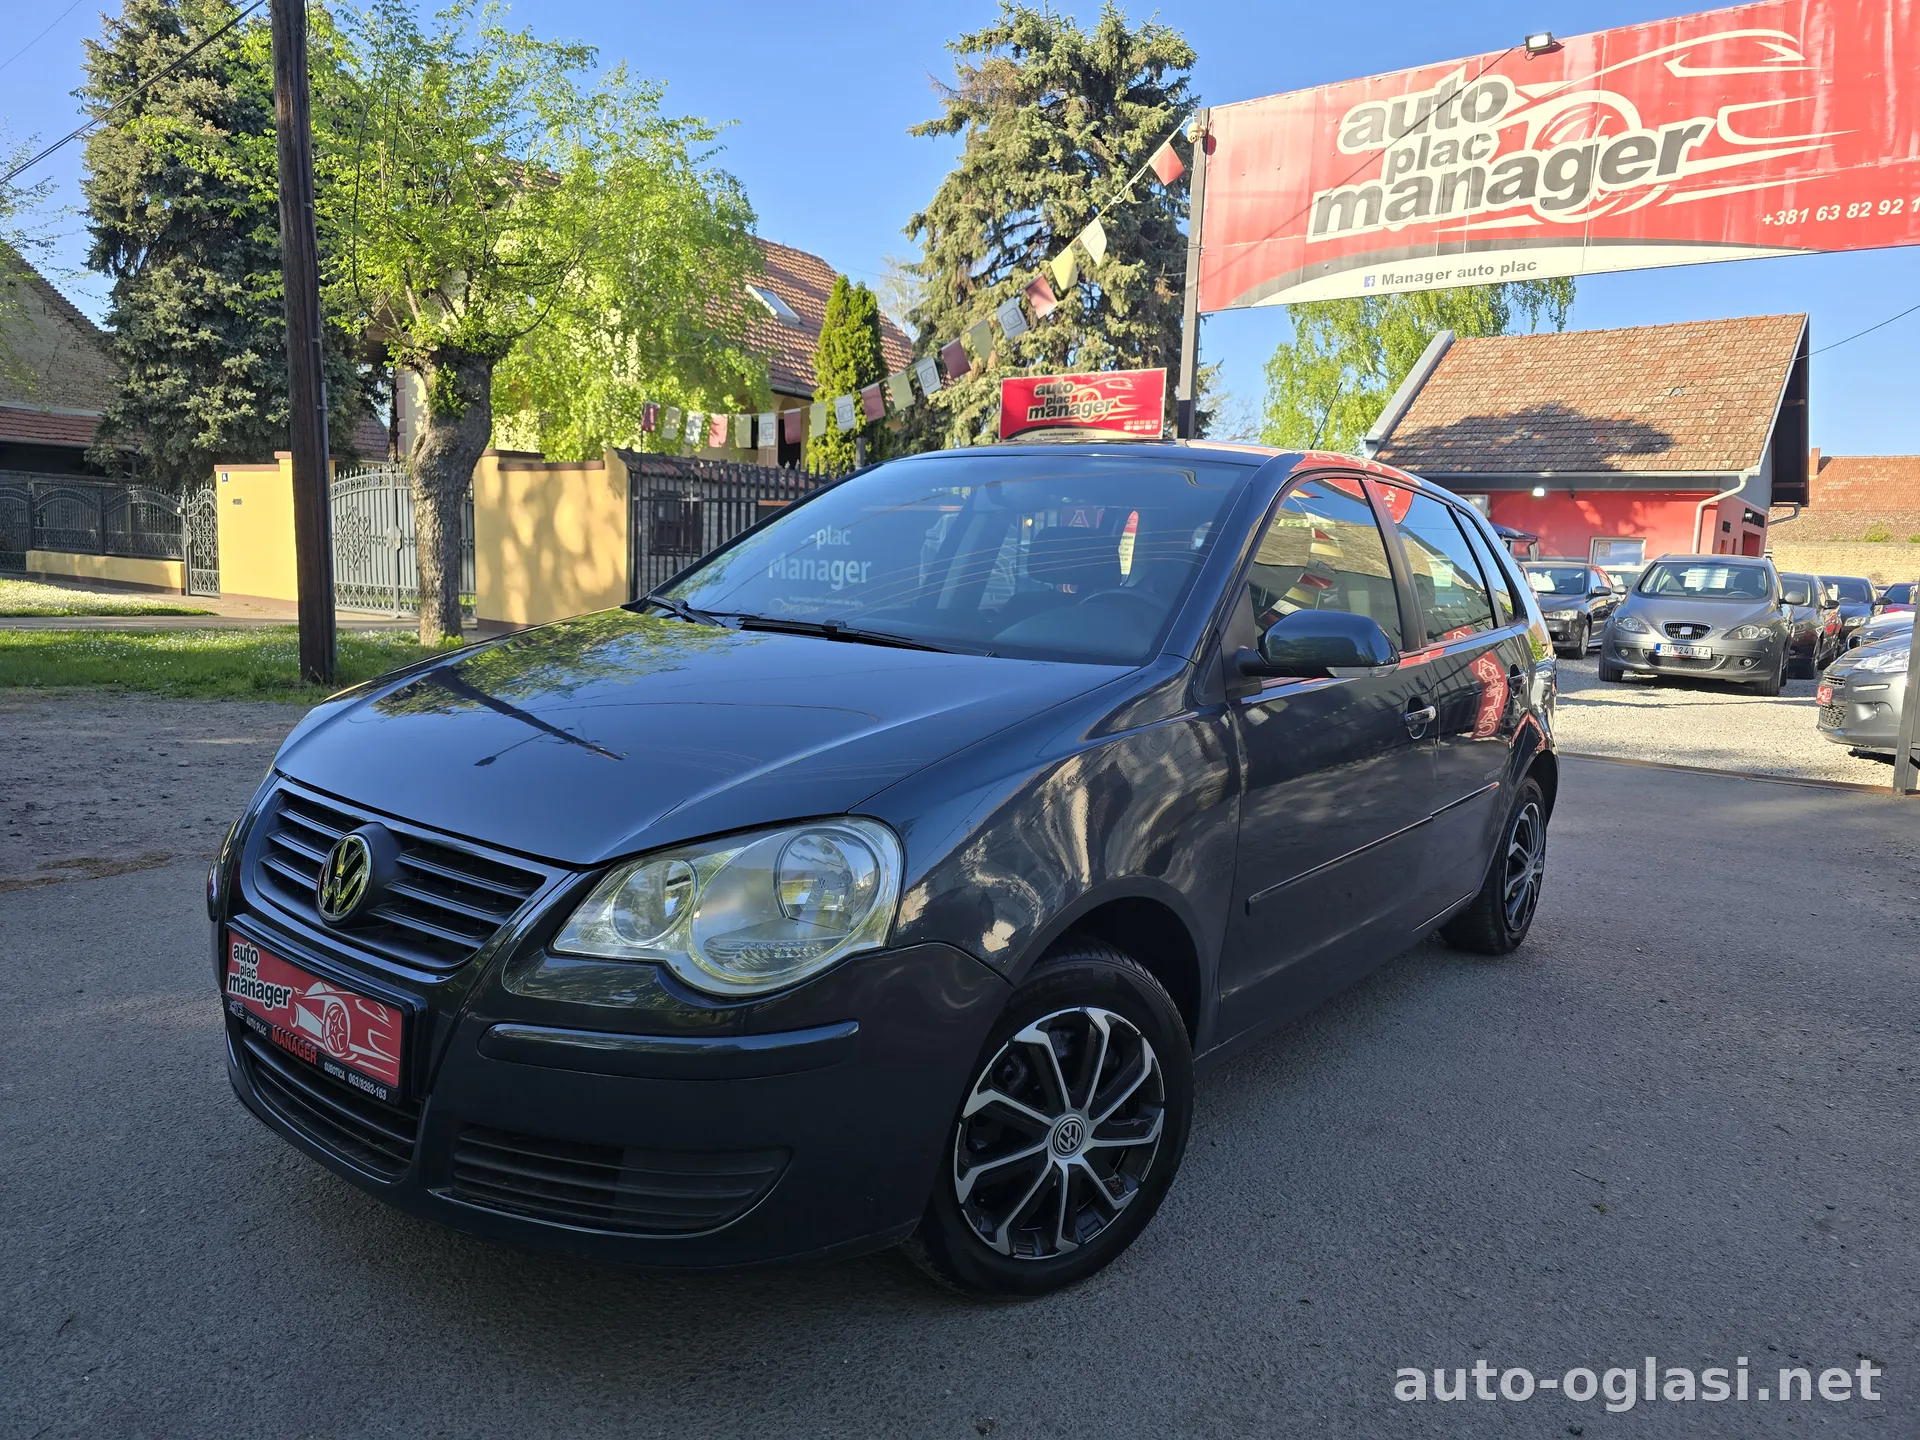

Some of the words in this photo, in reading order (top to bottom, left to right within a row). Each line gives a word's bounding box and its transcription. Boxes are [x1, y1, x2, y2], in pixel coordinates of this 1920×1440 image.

[1342, 76, 1509, 148] auto
[1385, 133, 1493, 185] plac
[1312, 123, 1706, 236] manager
[1762, 207, 1810, 226] +381
[1816, 204, 1841, 222] 63
[1846, 201, 1873, 219] 82
[1877, 198, 1904, 216] 92
[1381, 269, 1452, 286] Manager
[1456, 264, 1494, 278] auto
[1499, 260, 1537, 276] plac
[1035, 381, 1074, 396] auto
[1045, 395, 1070, 407] plac
[1028, 400, 1113, 420] manager
[768, 552, 872, 591] Manager
[233, 943, 259, 965] auto
[240, 963, 257, 979] plac
[228, 974, 291, 1008] manager
